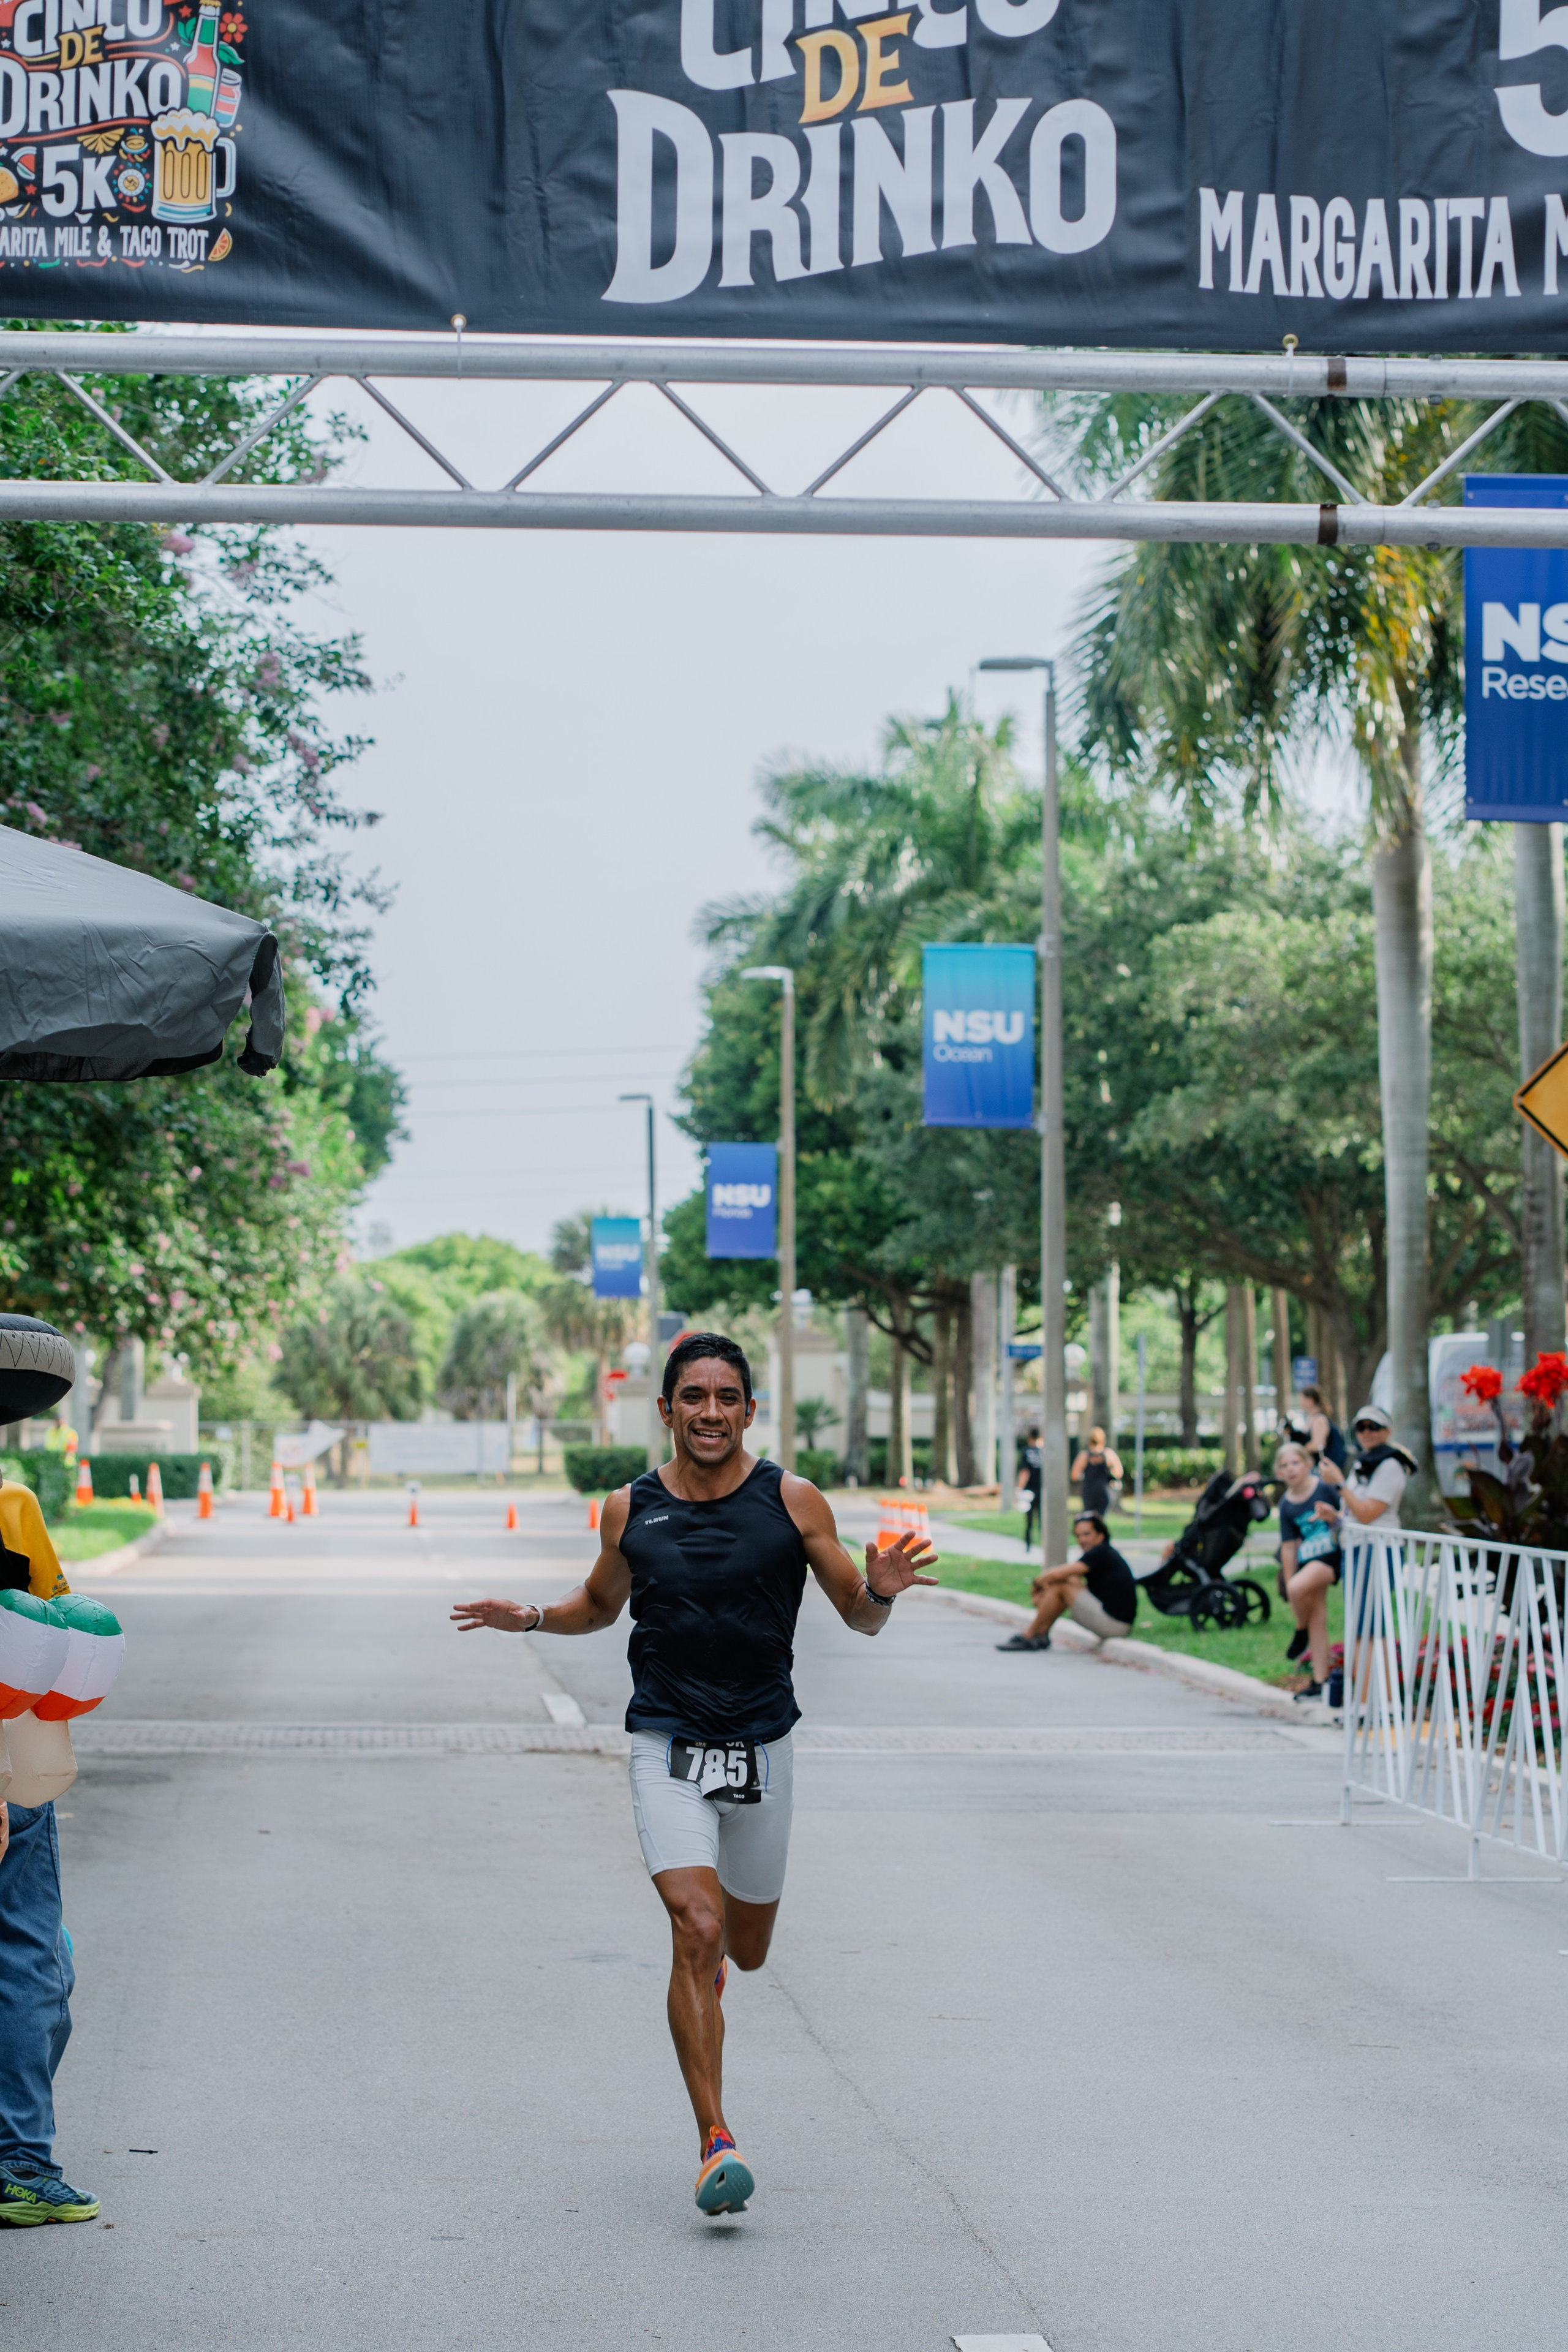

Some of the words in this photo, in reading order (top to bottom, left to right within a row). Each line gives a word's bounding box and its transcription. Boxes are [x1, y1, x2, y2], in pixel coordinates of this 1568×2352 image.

[59, 26, 105, 70] DE
[796, 13, 914, 123] DE
[0, 58, 182, 139] DRINKO
[41, 143, 118, 217] 5K
[601, 89, 1117, 304] DRINKO
[54, 226, 92, 257] MILE
[97, 225, 112, 257] &
[120, 225, 162, 257] TACO
[167, 227, 209, 262] TROT
[1198, 186, 1522, 300] MARGARITA
[1482, 666, 1568, 701] Rese
[933, 1009, 1025, 1045] NSU
[932, 1043, 993, 1063] Ocean
[712, 1183, 772, 1208] NSU
[686, 1746, 748, 1789] 785
[4, 2183, 37, 2204] HOKA
